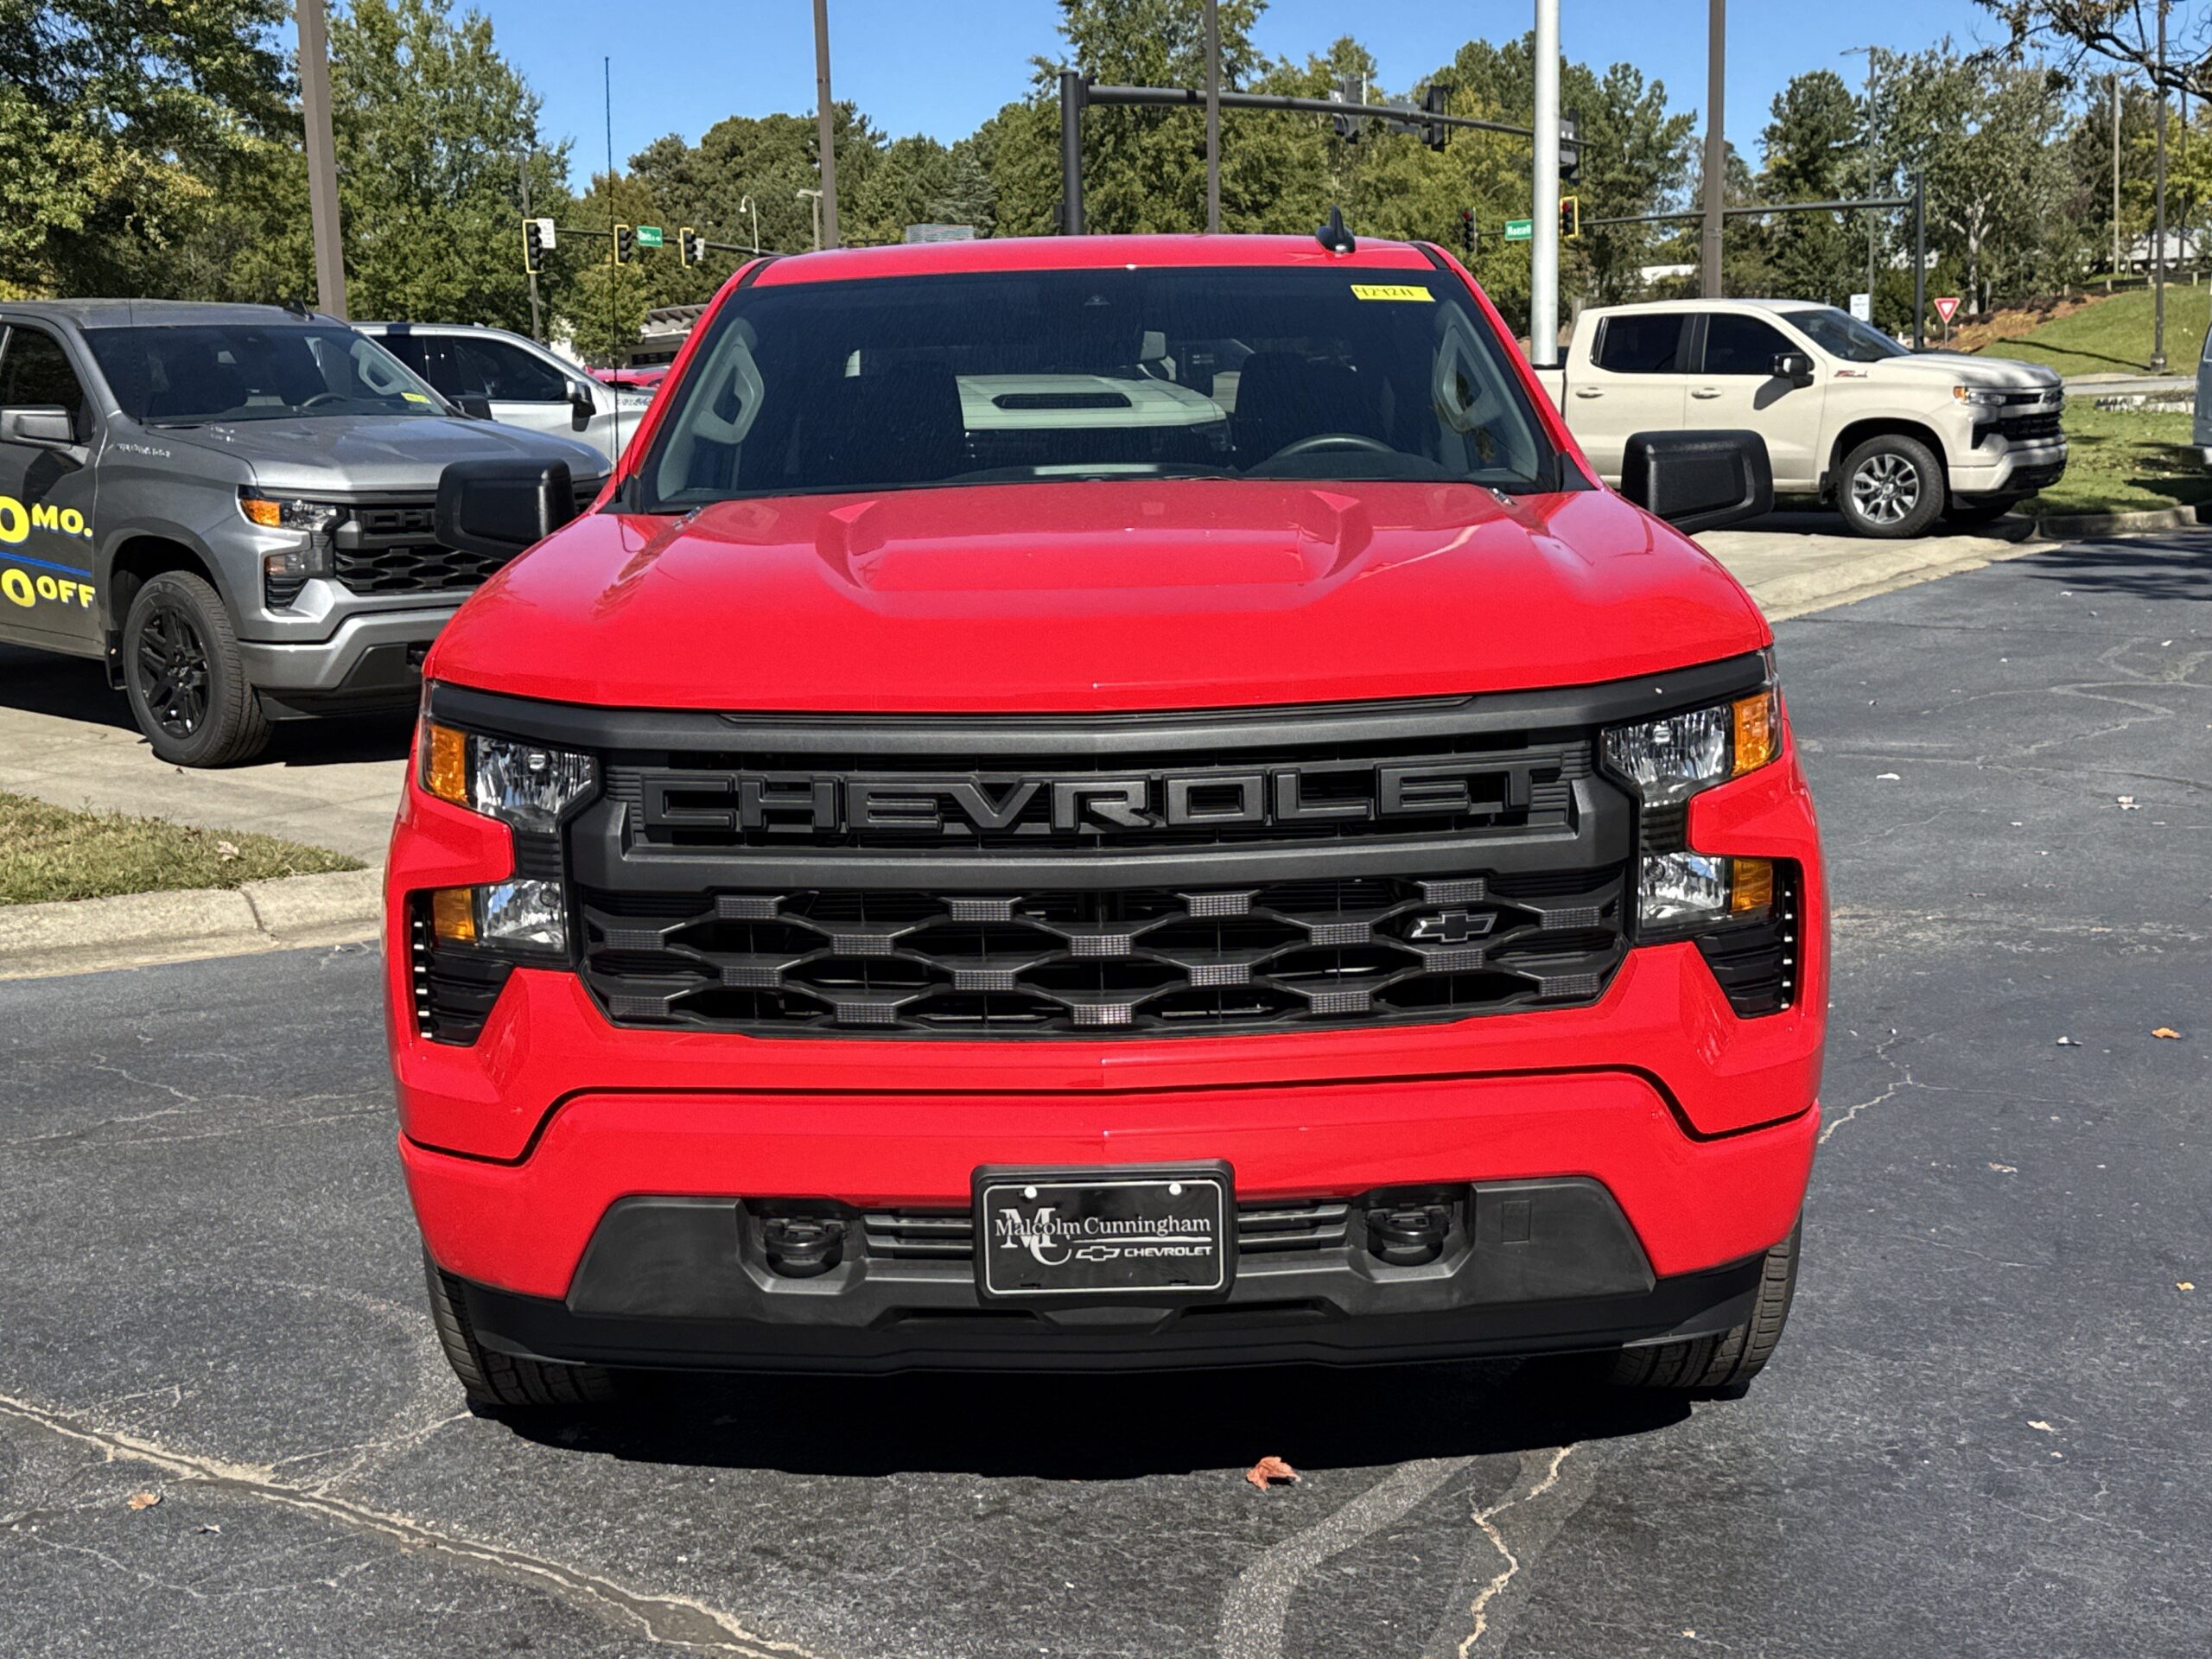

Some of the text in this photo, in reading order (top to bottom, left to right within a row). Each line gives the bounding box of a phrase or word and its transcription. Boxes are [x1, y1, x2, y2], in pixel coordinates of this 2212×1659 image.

[36, 575, 96, 608] OFF
[642, 757, 1562, 830] CHEVROLET
[995, 1215, 1212, 1237] Malcolm Cunningham
[1124, 1245, 1213, 1258] CHEVROLET
